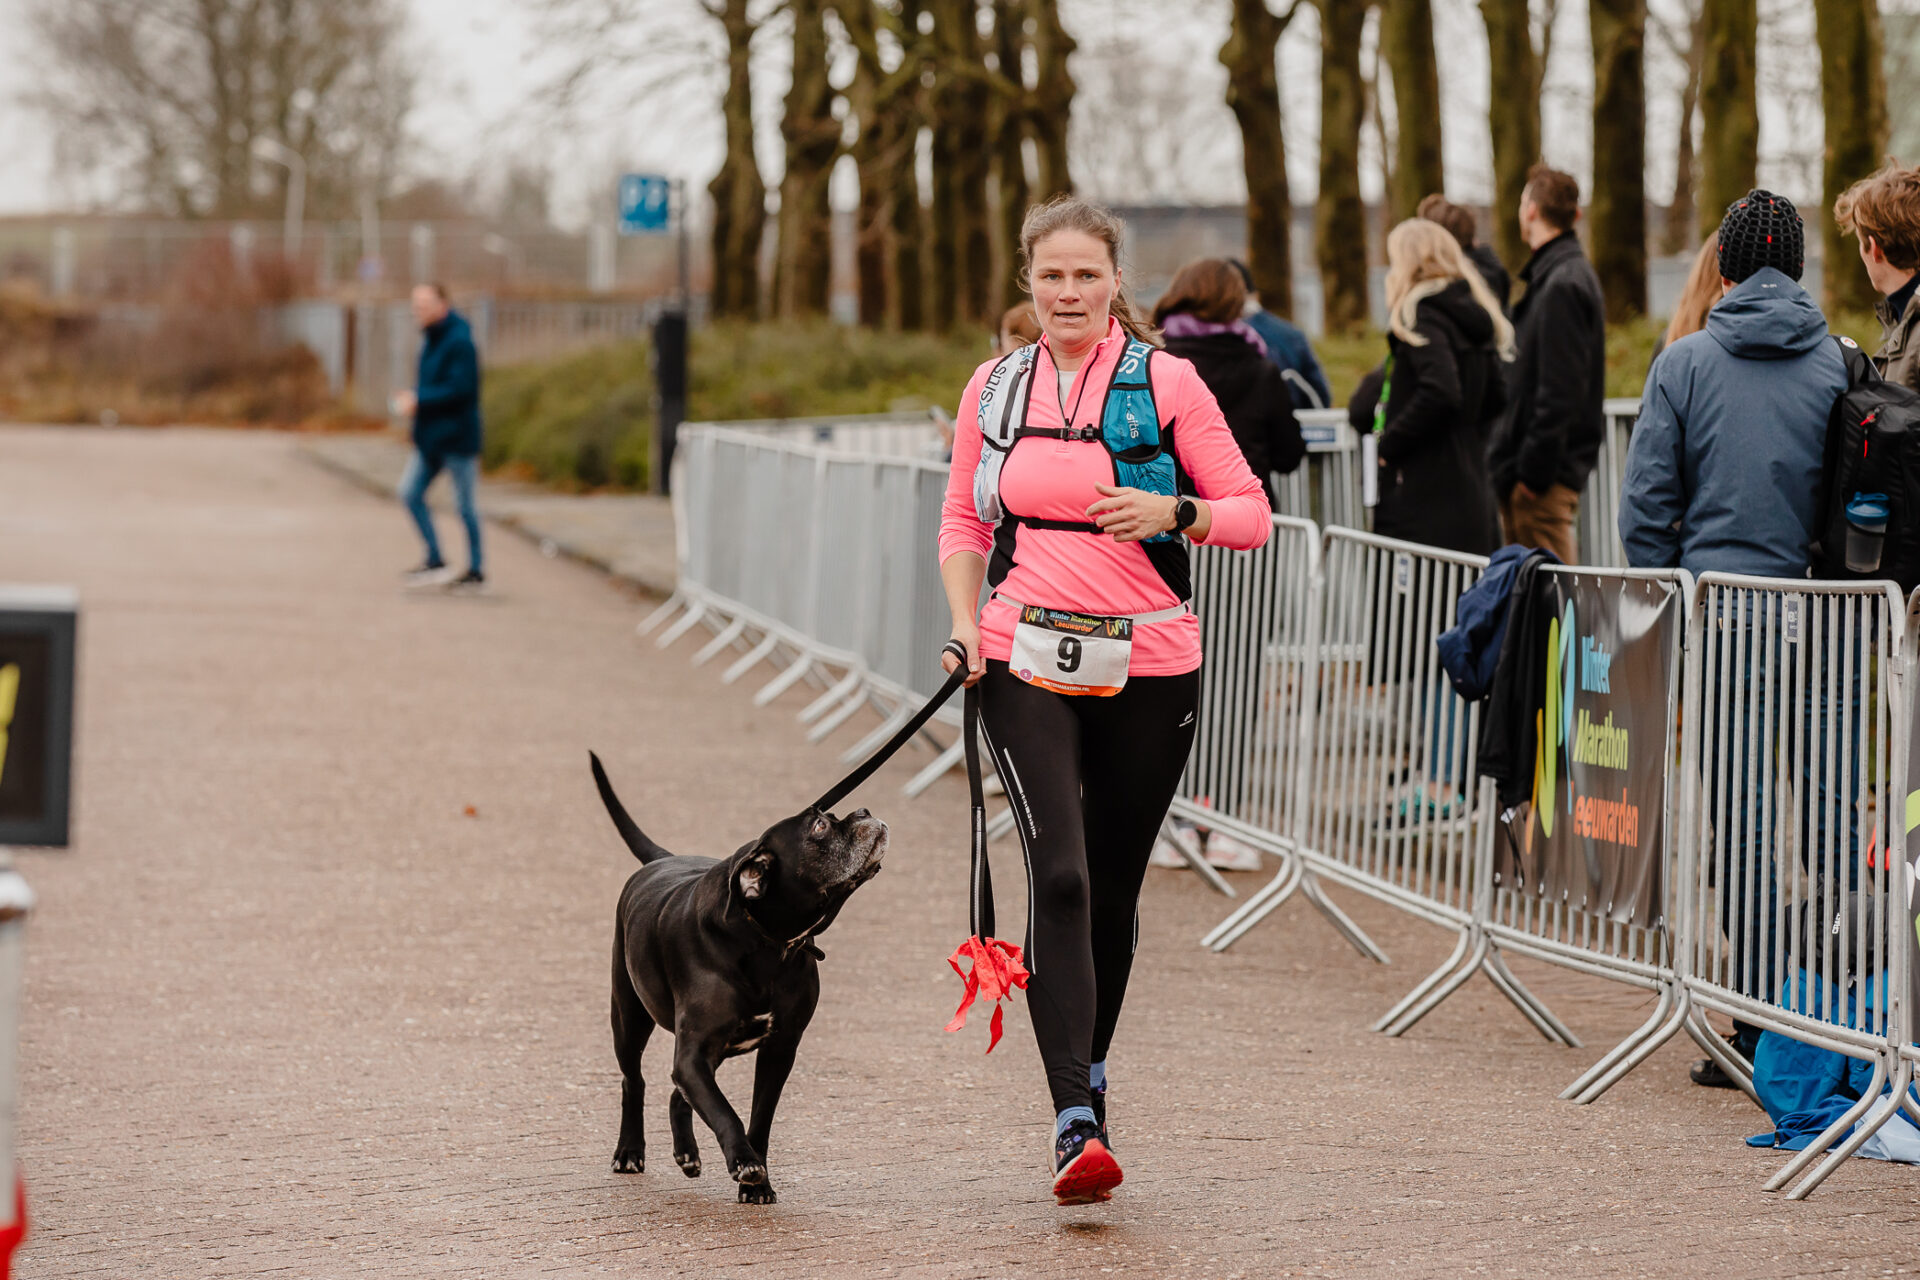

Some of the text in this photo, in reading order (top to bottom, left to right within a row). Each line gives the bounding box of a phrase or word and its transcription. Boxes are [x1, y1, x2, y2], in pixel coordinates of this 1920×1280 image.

[1049, 610, 1071, 621] Winter
[1054, 619, 1094, 633] Leeuwarden
[1056, 636, 1083, 673] 9
[1573, 708, 1629, 771] Marathon
